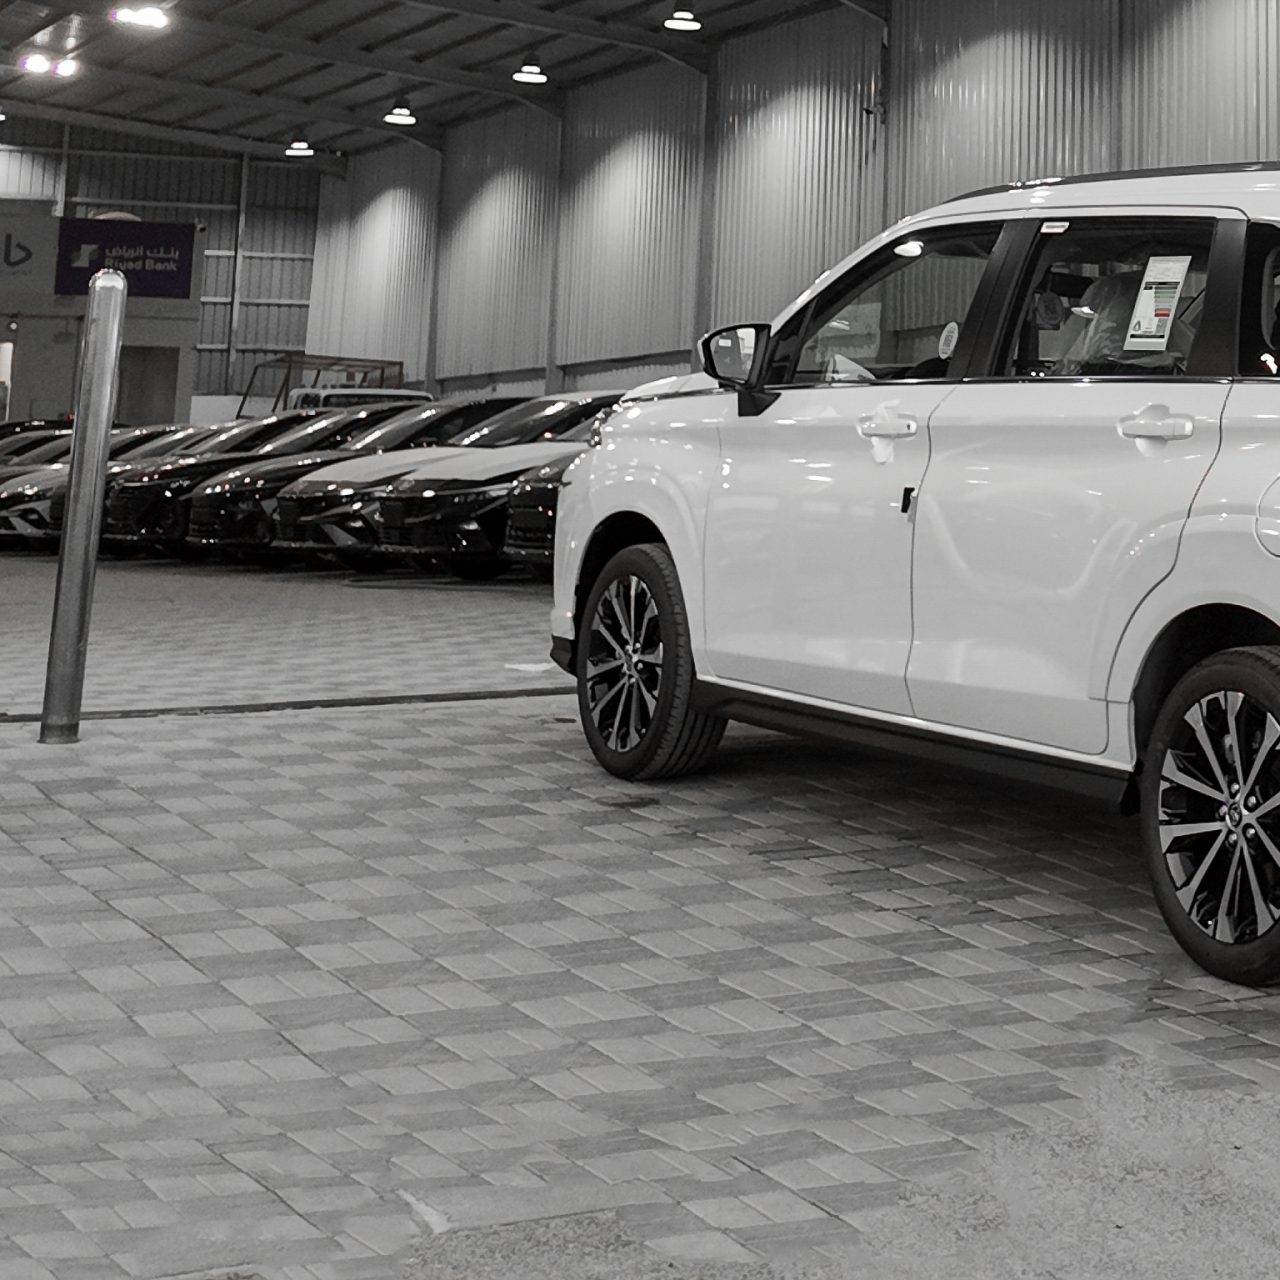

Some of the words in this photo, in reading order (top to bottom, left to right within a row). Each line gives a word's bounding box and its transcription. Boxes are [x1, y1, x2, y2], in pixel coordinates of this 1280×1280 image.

[104, 244, 144, 259] الرياض
[104, 257, 142, 271] Riyad
[145, 258, 178, 271] Bank
